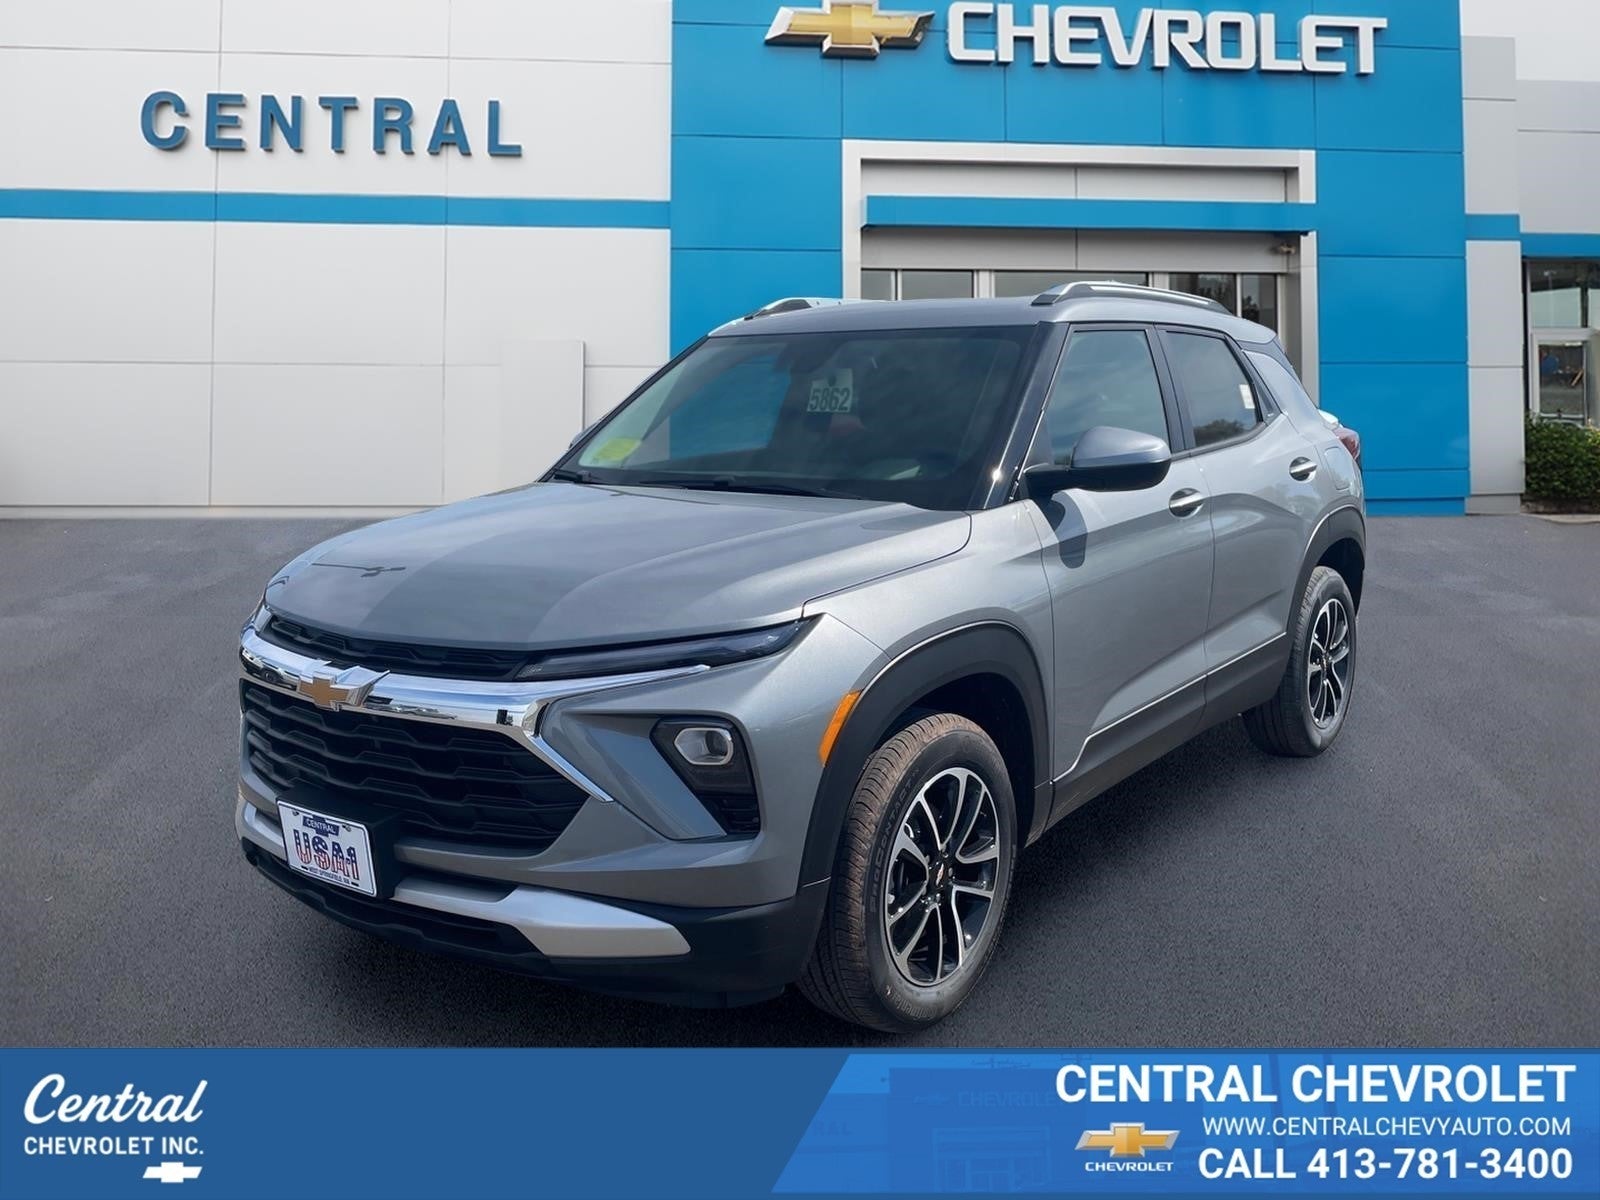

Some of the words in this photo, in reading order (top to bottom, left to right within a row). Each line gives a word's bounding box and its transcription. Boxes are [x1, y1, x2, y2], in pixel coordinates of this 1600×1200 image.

[946, 1, 1388, 76] CHEVROLET
[140, 90, 523, 157] CENTRAL
[809, 386, 850, 410] 5862
[305, 817, 337, 834] CENTRAL
